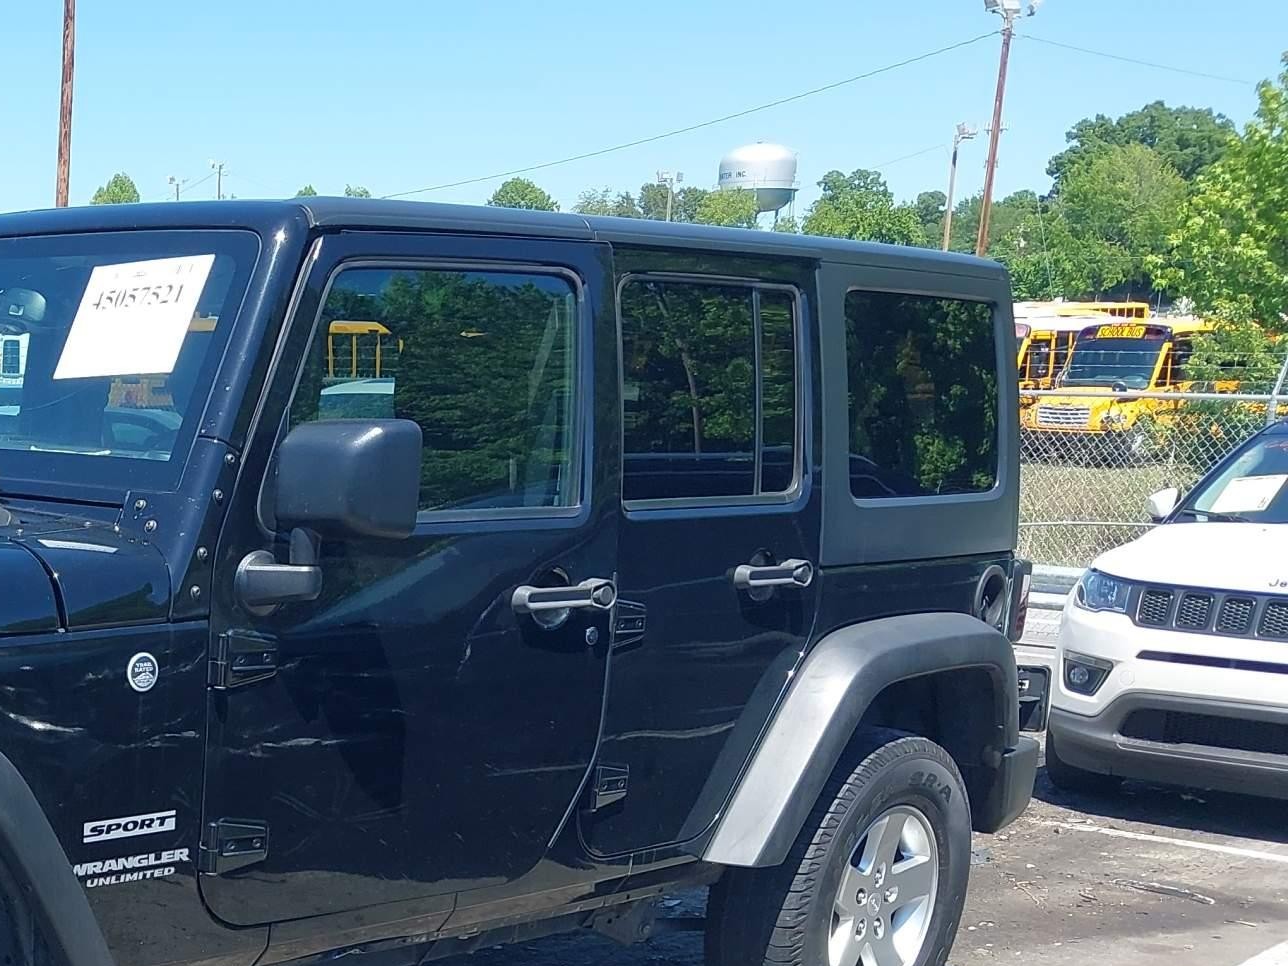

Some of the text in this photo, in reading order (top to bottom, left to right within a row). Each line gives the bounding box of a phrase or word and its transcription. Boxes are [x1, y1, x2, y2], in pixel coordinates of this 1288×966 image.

[92, 284, 184, 310] 45057521
[1099, 327, 1144, 337] SCHOOL BUS
[85, 815, 174, 837] SPORT
[73, 847, 192, 877] WRANGLER
[86, 866, 175, 888] UNLIMITED
